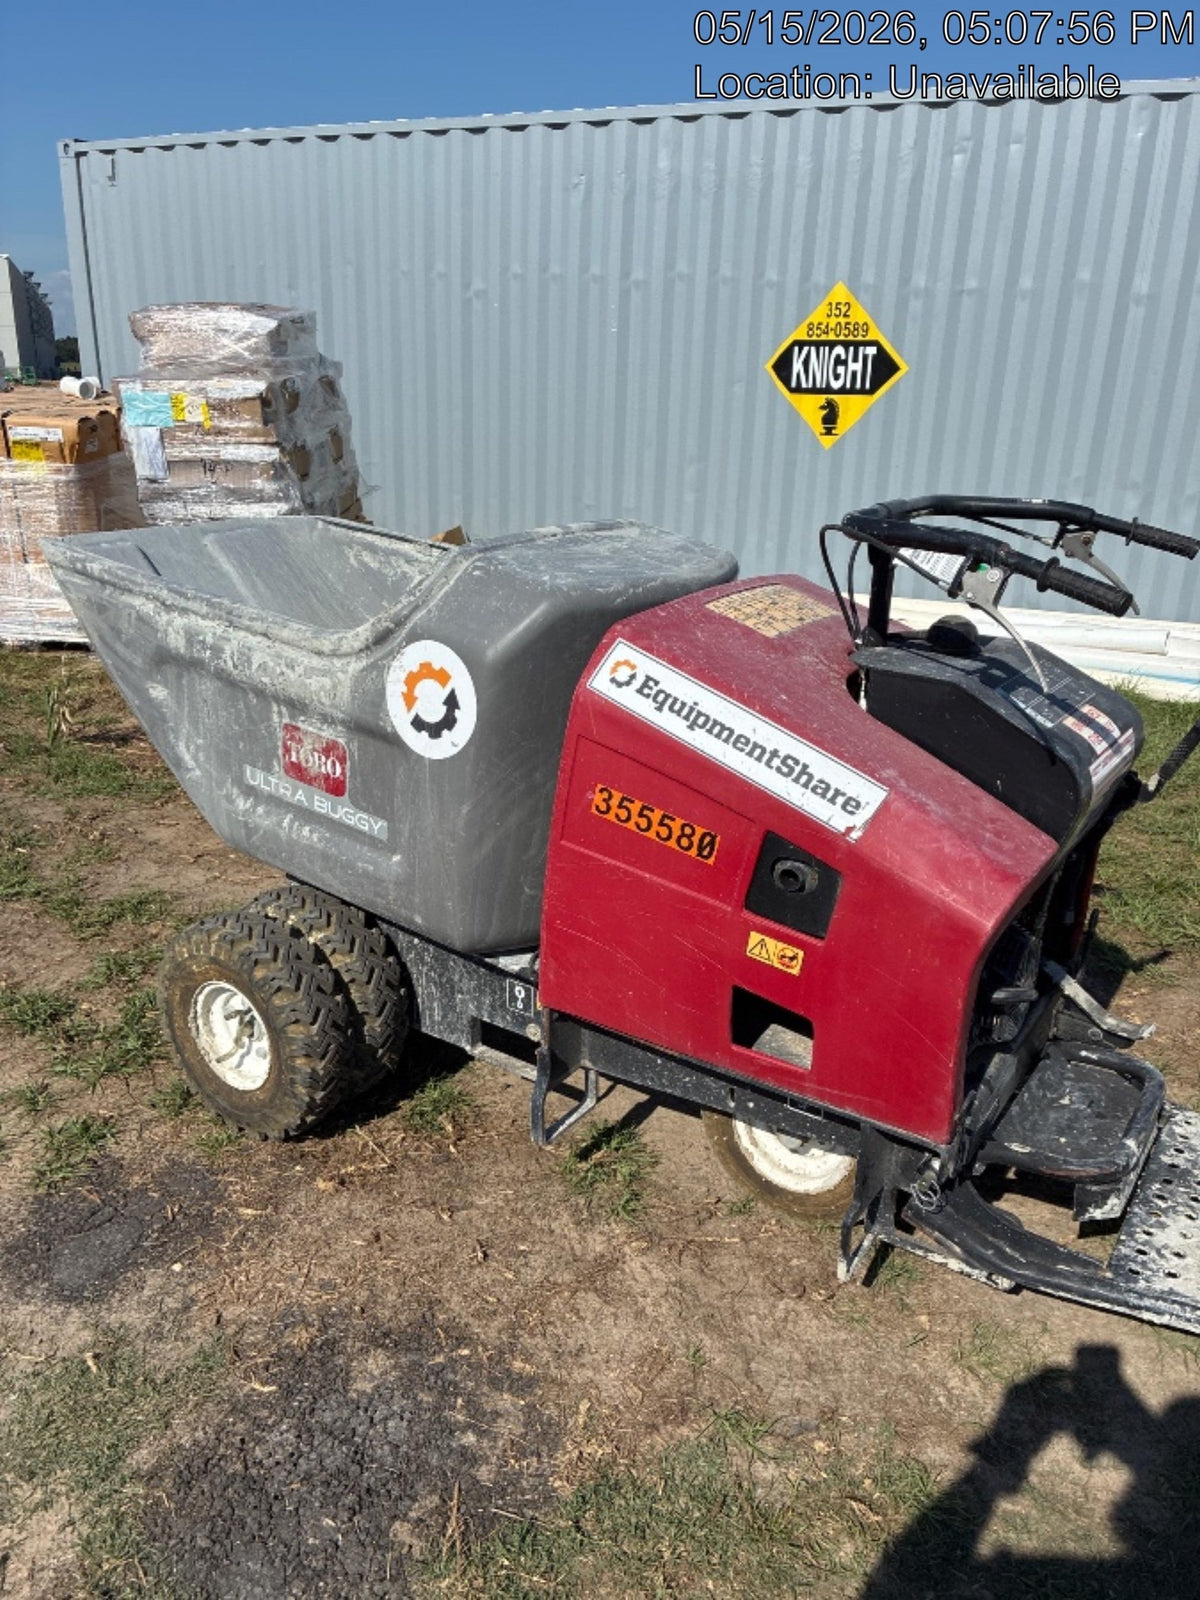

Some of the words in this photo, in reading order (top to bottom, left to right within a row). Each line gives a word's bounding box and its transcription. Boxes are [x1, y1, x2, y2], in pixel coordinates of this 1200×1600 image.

[806, 321, 870, 339] 854-0589
[826, 301, 851, 318] 352
[790, 344, 878, 390] KNIGHT
[286, 739, 342, 778] TORO
[634, 673, 863, 816] EquipmentShare
[244, 767, 309, 807] ULTRA
[313, 794, 384, 836] BUGGY
[592, 785, 720, 862] 355580
